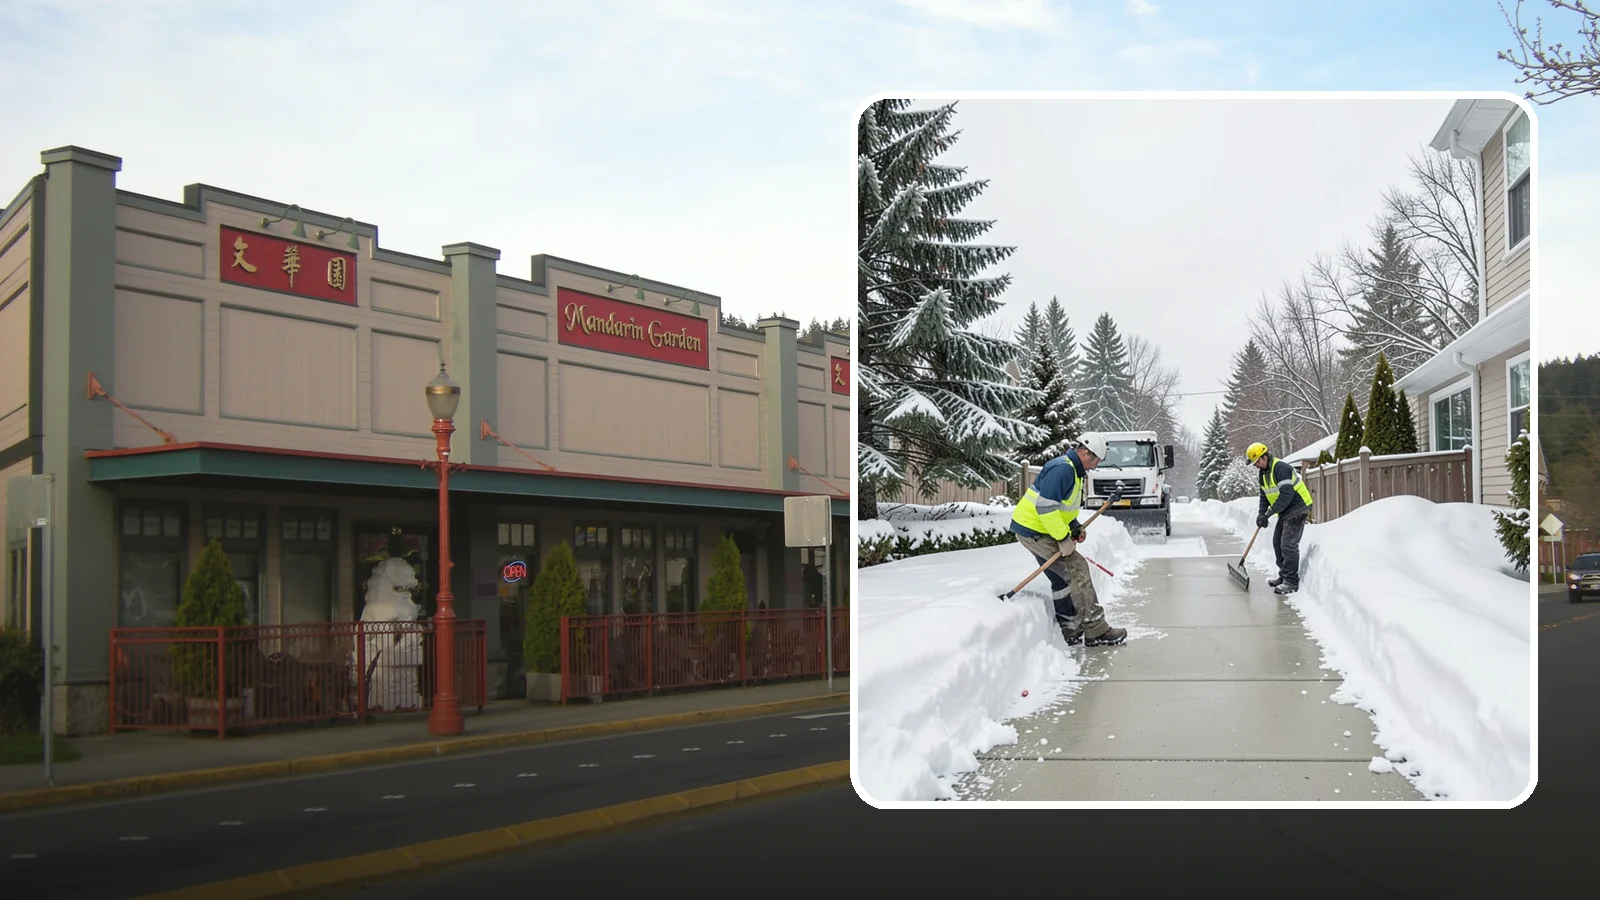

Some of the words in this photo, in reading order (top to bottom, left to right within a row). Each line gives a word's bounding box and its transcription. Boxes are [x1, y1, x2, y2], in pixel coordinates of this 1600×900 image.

[231, 235, 346, 291] 文華園
[564, 302, 644, 341] Mandarin
[648, 320, 702, 352] Garden
[503, 565, 527, 578] OPEN
